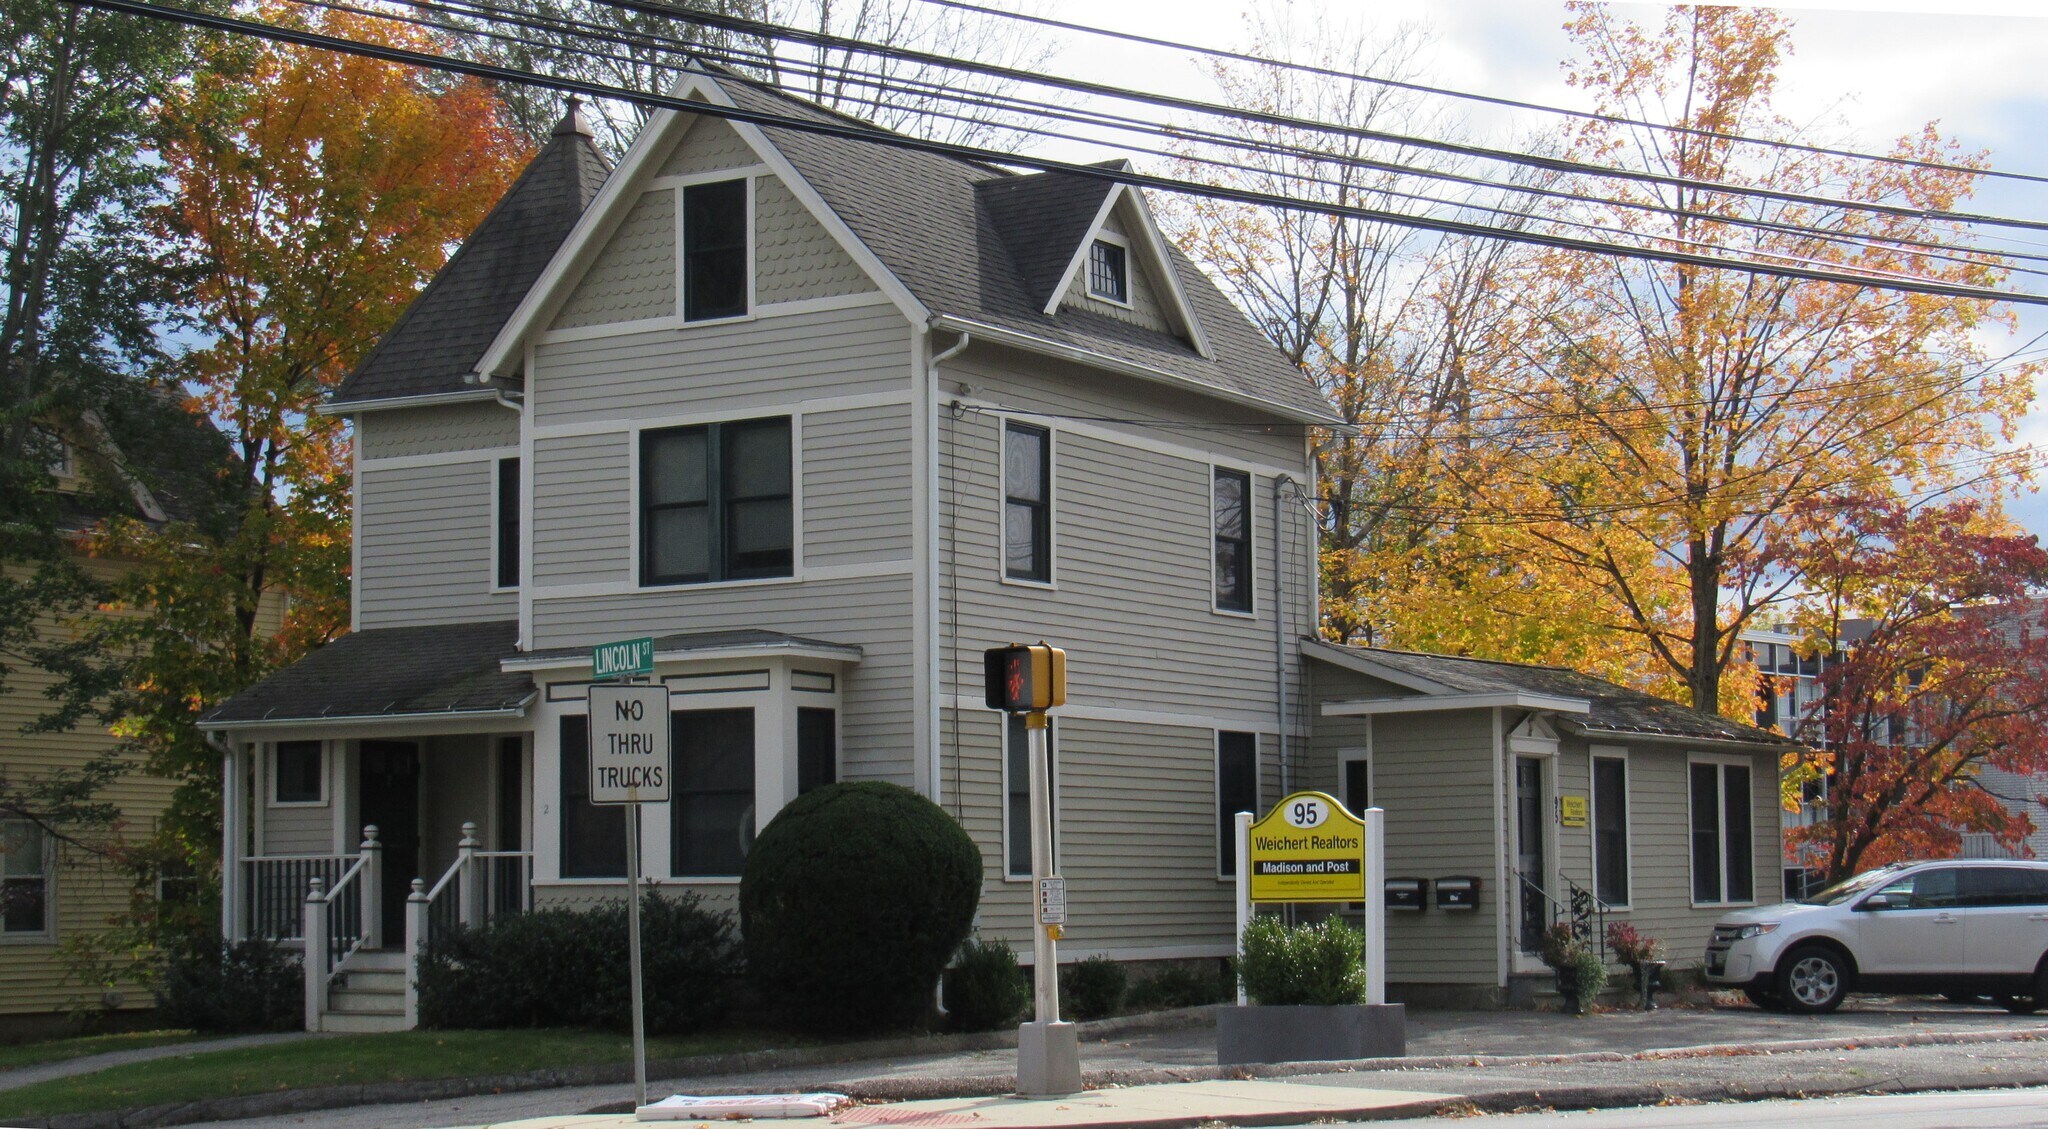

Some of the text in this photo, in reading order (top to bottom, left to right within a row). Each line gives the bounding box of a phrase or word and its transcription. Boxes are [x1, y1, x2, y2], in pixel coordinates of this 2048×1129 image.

[595, 641, 650, 674] LINCOLN ST
[615, 699, 644, 721] NO
[607, 733, 653, 755] THRU
[598, 766, 663, 788] TRUCKS
[1293, 802, 1318, 824] 95
[1255, 835, 1359, 851] Weichert Realtors
[1262, 861, 1349, 873] Madison and Post
